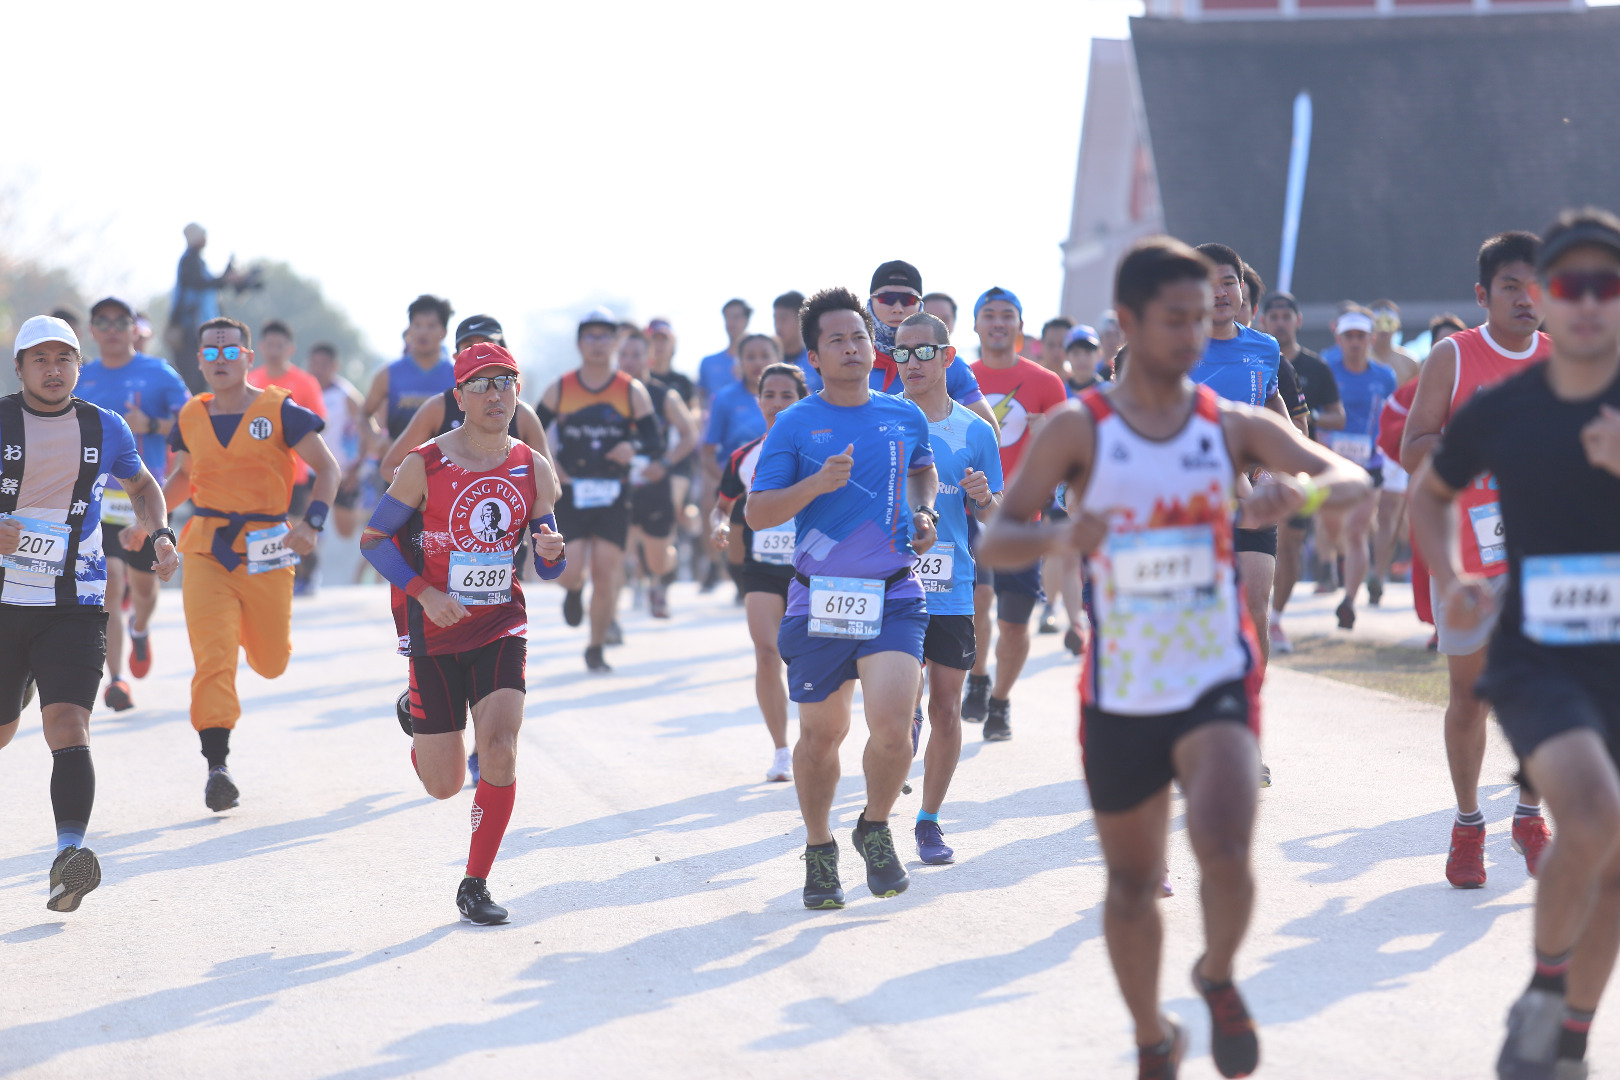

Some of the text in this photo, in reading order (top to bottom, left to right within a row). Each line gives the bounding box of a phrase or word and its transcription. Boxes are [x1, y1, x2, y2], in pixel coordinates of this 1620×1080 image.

[885, 440, 897, 525] CROSS COUNTRY RUN
[457, 483, 521, 519] SIANG PURE
[18, 535, 55, 555] 207
[763, 535, 796, 550] 6393
[912, 557, 942, 575] 263
[463, 568, 506, 587] 6389
[826, 595, 867, 615] 6193
